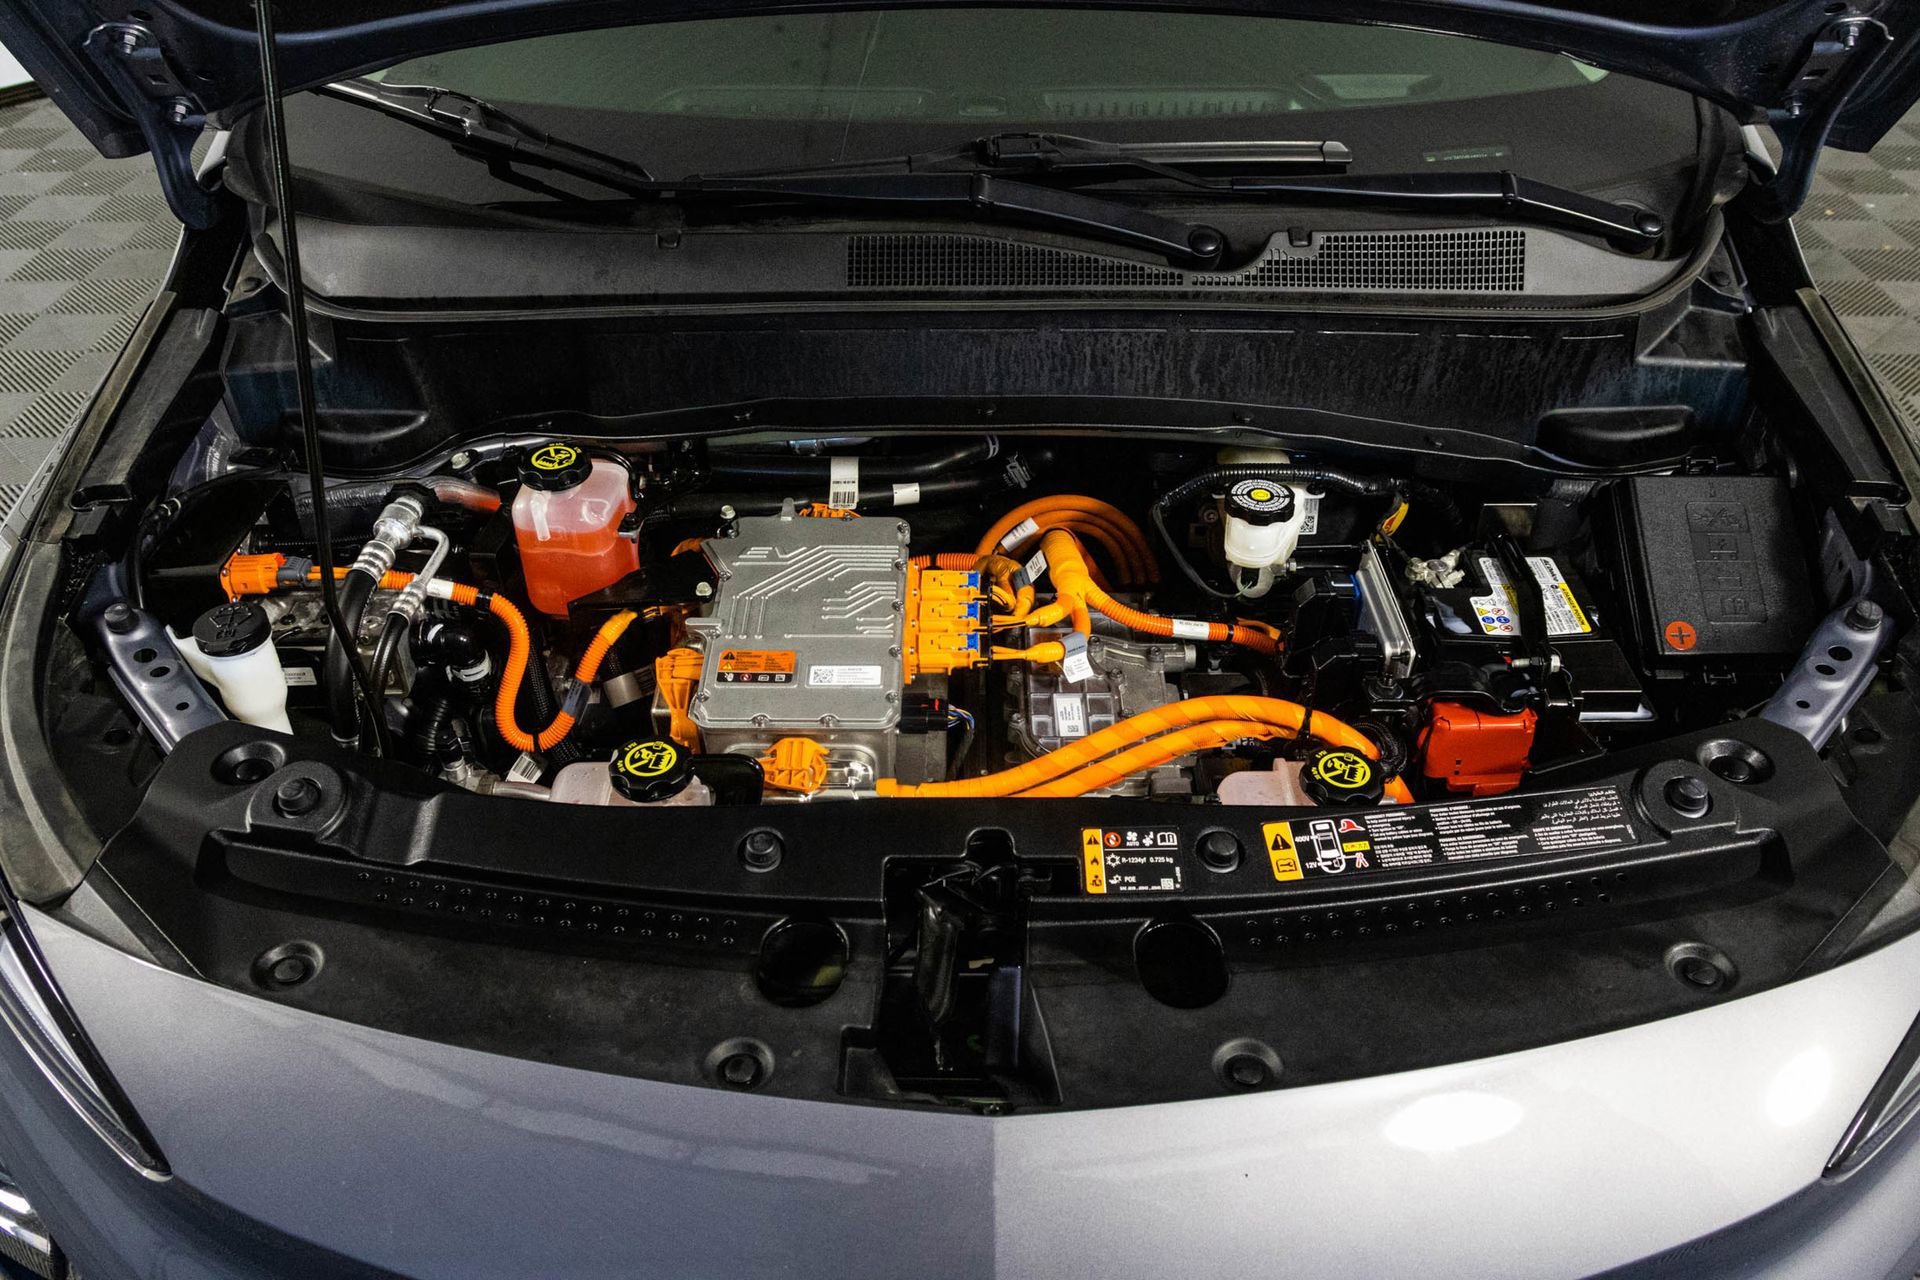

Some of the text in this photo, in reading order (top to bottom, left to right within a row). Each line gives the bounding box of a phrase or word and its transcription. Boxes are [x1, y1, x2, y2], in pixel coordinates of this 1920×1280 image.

[1295, 835, 1310, 843] 400V
[1165, 856, 1174, 864] kg
[1305, 861, 1317, 869] 12V
